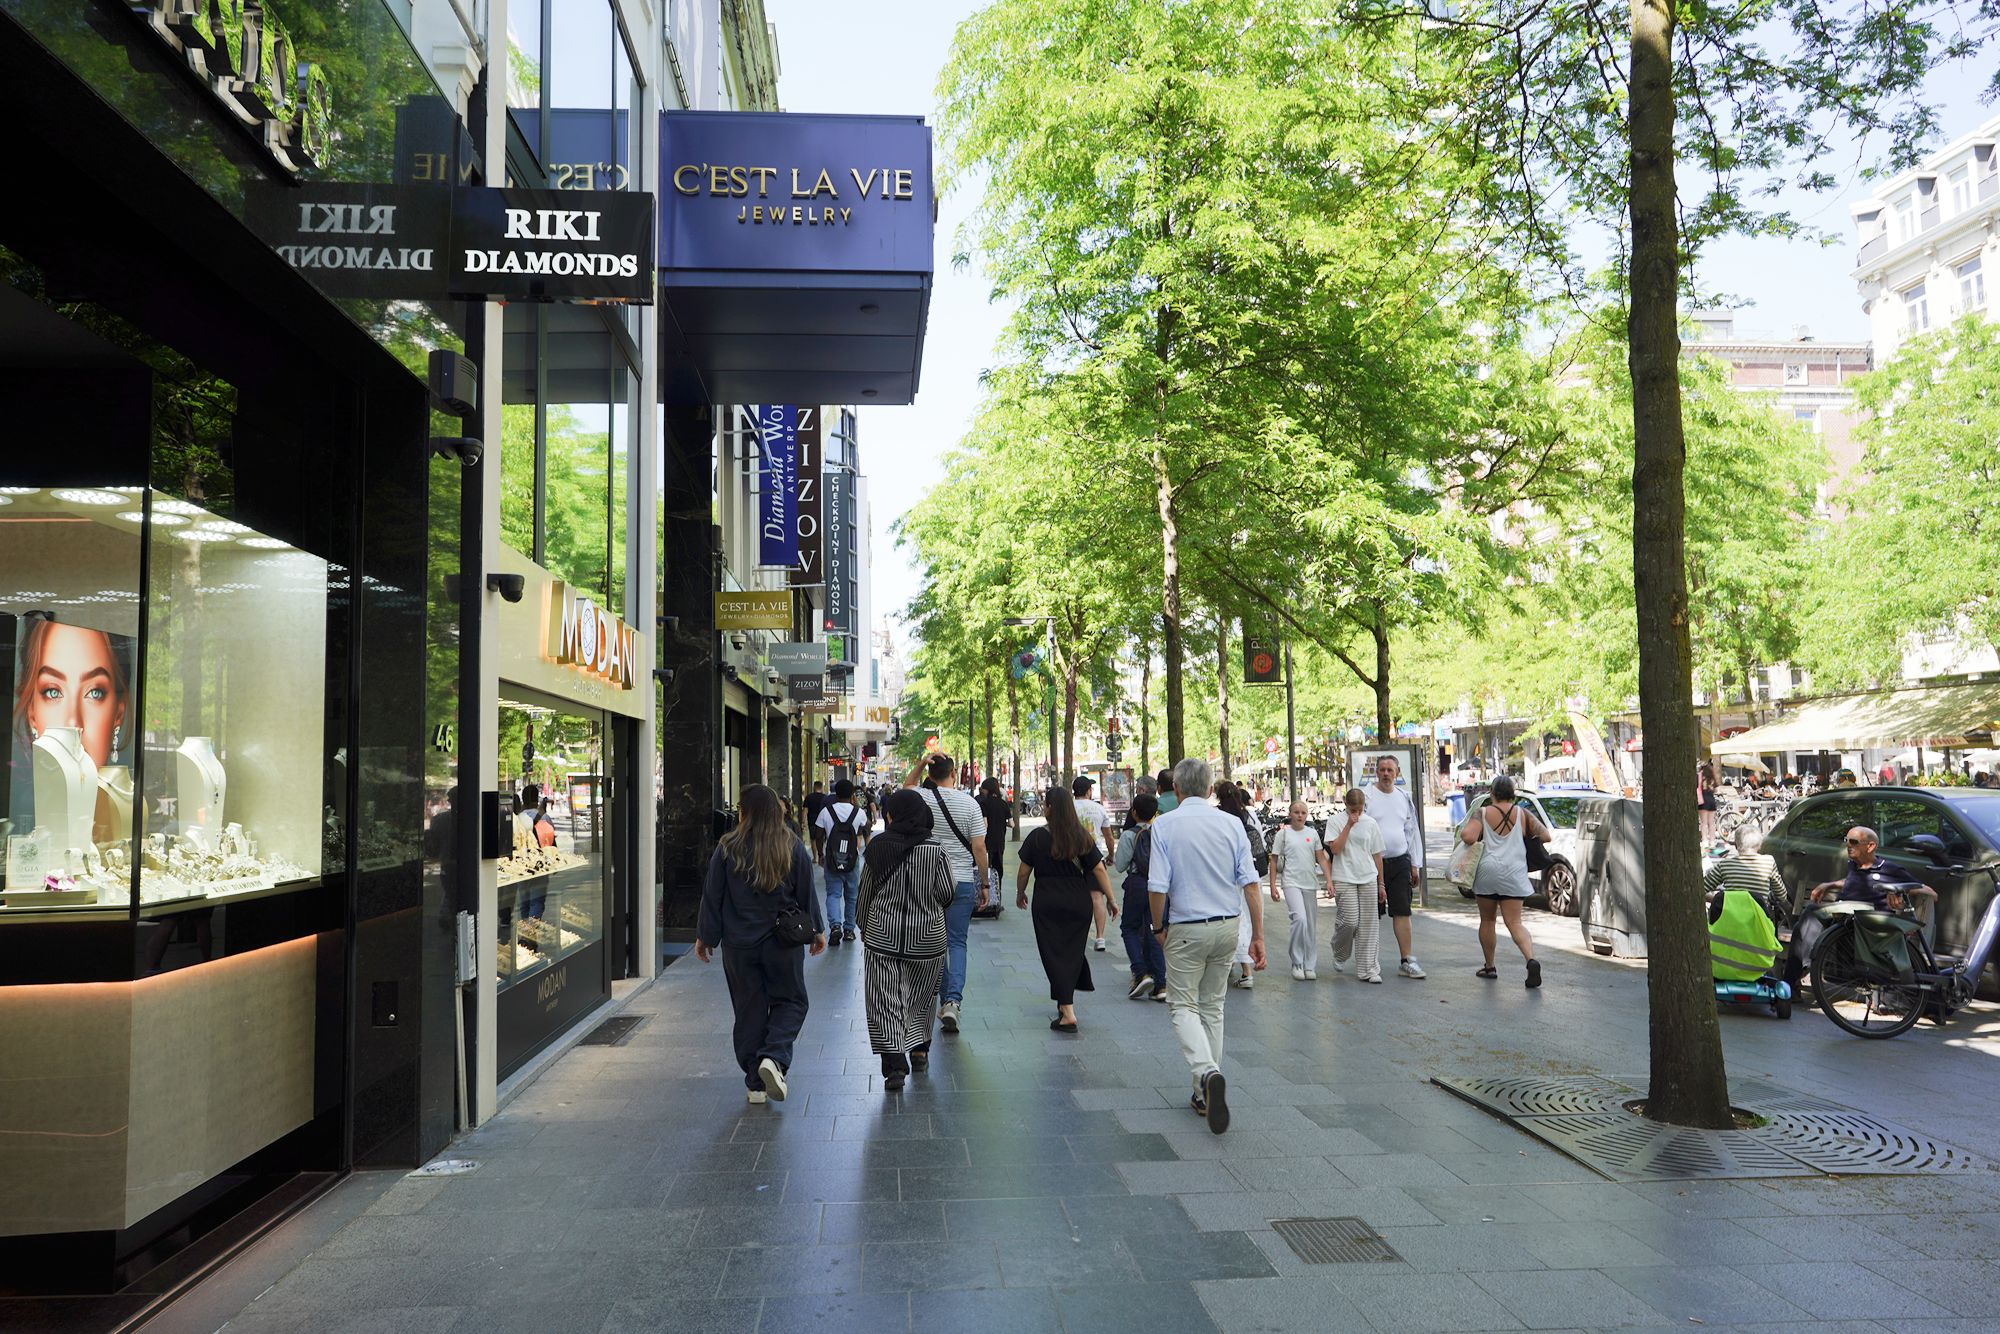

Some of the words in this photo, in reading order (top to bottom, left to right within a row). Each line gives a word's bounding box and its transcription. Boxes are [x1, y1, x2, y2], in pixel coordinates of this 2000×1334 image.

[673, 162, 777, 198] C'EST
[790, 167, 838, 199] LA
[851, 168, 913, 200] VIE
[504, 208, 601, 241] RIKI
[737, 206, 851, 225] JEWELRY
[464, 249, 638, 277] DIAMONDS
[786, 425, 795, 493] ANTWERP
[797, 408, 817, 574] ZIZOV
[831, 476, 840, 555] CHECKPOINT
[831, 560, 840, 615] DIAMOND
[719, 601, 749, 612] C'EST
[752, 601, 766, 611] LA
[769, 601, 788, 611] VIE
[553, 584, 637, 689] MODANI
[771, 651, 798, 660] Diamond
[795, 680, 820, 688] ZIZOV
[432, 724, 454, 752] 46
